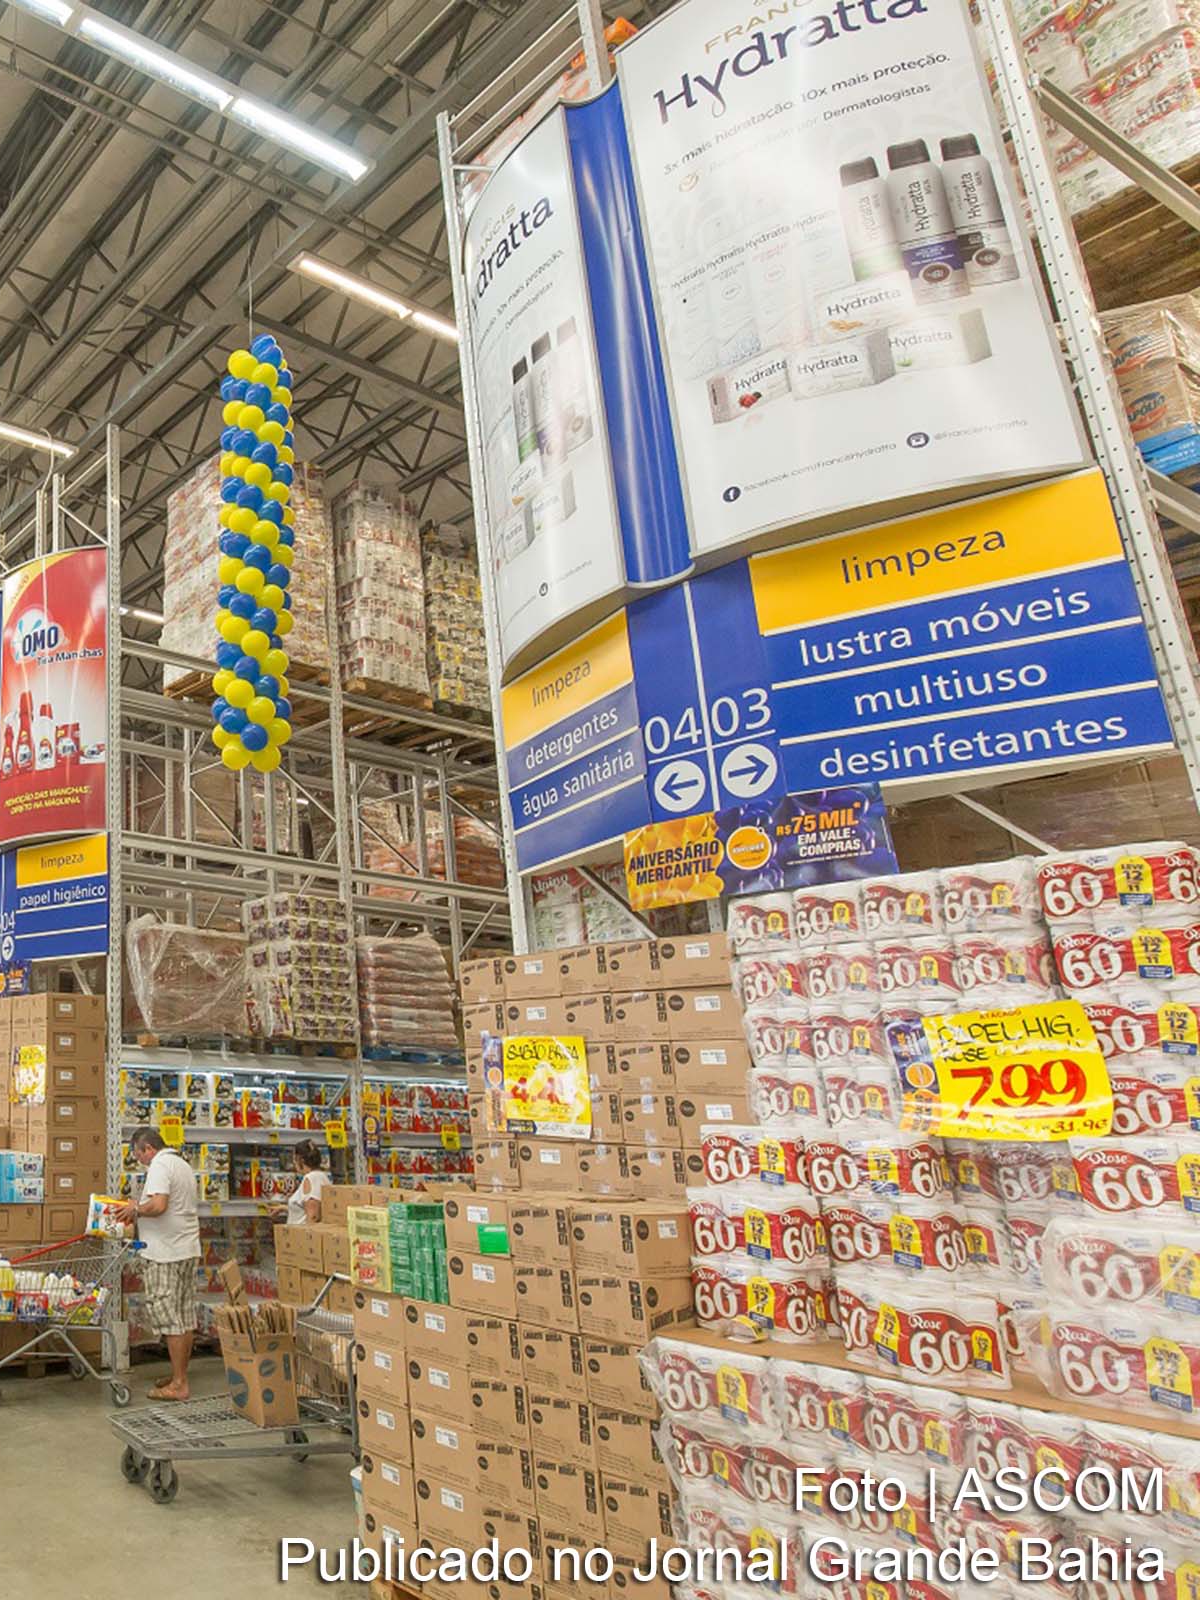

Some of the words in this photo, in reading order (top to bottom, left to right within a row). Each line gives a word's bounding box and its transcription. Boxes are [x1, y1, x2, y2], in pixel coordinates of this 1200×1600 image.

[653, 0, 928, 125] Hydratta
[831, 72, 870, 93] mais
[826, 289, 903, 318] Hydratta
[840, 528, 1007, 585] limpeza
[22, 626, 59, 657] OMO
[800, 626, 912, 667] lustra
[928, 587, 1092, 643] móveis
[531, 658, 593, 707] limpeza
[854, 662, 1050, 717] multiuso
[644, 707, 702, 755] 04
[711, 687, 772, 738] 03
[525, 706, 620, 770] detergentes
[819, 715, 1129, 780] desinfetantes
[522, 787, 559, 819] água
[562, 748, 636, 799] sanitária
[628, 840, 721, 874] ANIVERSÁRIO
[798, 835, 816, 846] EM
[799, 838, 862, 858] COMPRAS
[41, 853, 84, 869] limpeza
[635, 859, 717, 887] MERCANTIL
[1122, 870, 1144, 881] 12
[20, 891, 50, 909] papel
[53, 883, 106, 905] higiênico
[943, 888, 986, 923] 60
[1043, 871, 1105, 915] 60
[796, 906, 831, 941] 60
[863, 896, 900, 931] 60
[1062, 942, 1123, 988] 60
[1142, 943, 1162, 954] 12
[808, 963, 846, 998] 60
[877, 960, 916, 997] 60
[954, 953, 999, 991] 60
[1165, 1010, 1189, 1018] LEVE
[1167, 1018, 1188, 1031] 12
[812, 1027, 850, 1061] 60
[1113, 1089, 1174, 1134] 60
[707, 1146, 751, 1183] 60
[764, 1150, 779, 1162] 12
[811, 1153, 859, 1194] 60
[873, 1159, 891, 1173] 12
[1087, 1150, 1129, 1166] Rose
[911, 1159, 943, 1198] 60
[1000, 1164, 1049, 1203] 60
[1093, 1163, 1164, 1212] 60
[694, 1216, 737, 1254] 60
[782, 1223, 817, 1264] 60
[830, 1222, 881, 1261] 60
[935, 1230, 968, 1272] 60
[1070, 1253, 1145, 1301] 60
[694, 1281, 738, 1320] 60
[907, 1314, 942, 1331] Rose
[909, 1330, 970, 1375] 60
[1058, 1343, 1131, 1396] 60
[663, 1369, 709, 1411] 60
[863, 1408, 920, 1456] 60
[751, 1460, 794, 1503] 60
